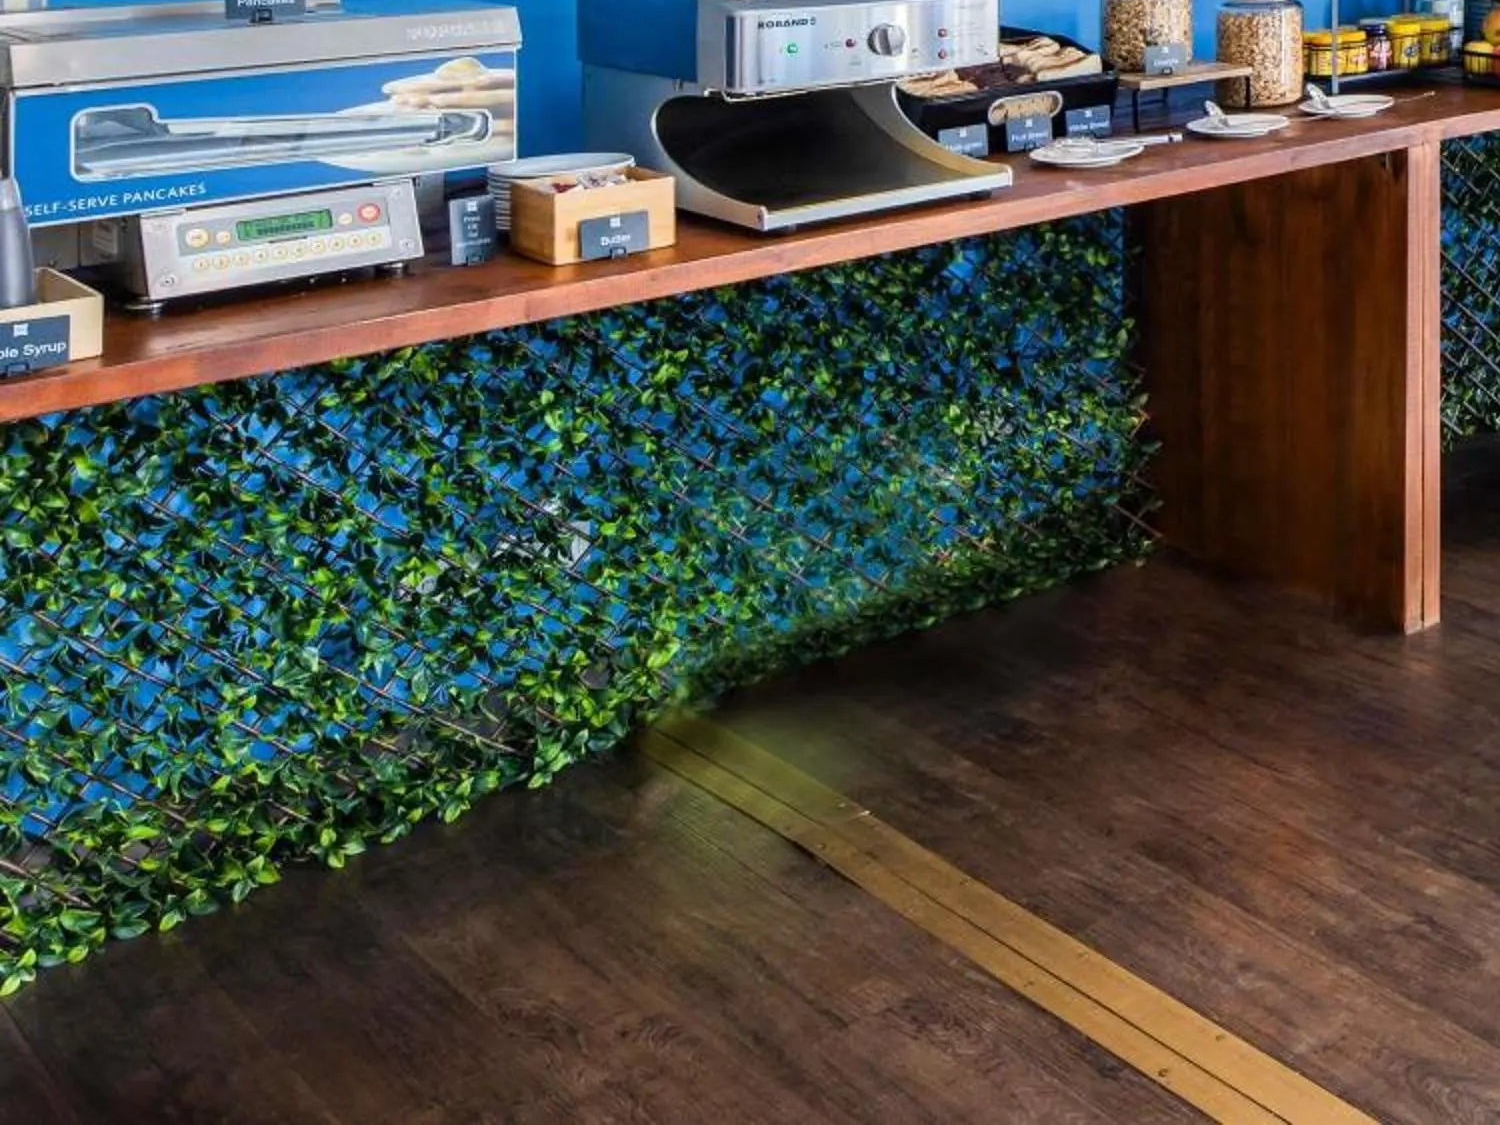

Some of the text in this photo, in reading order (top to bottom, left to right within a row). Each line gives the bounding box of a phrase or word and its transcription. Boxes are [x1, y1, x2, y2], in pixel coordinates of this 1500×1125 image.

[24, 182, 207, 217] SELF-SERVE PANCAKES
[23, 342, 67, 358] Syrup
